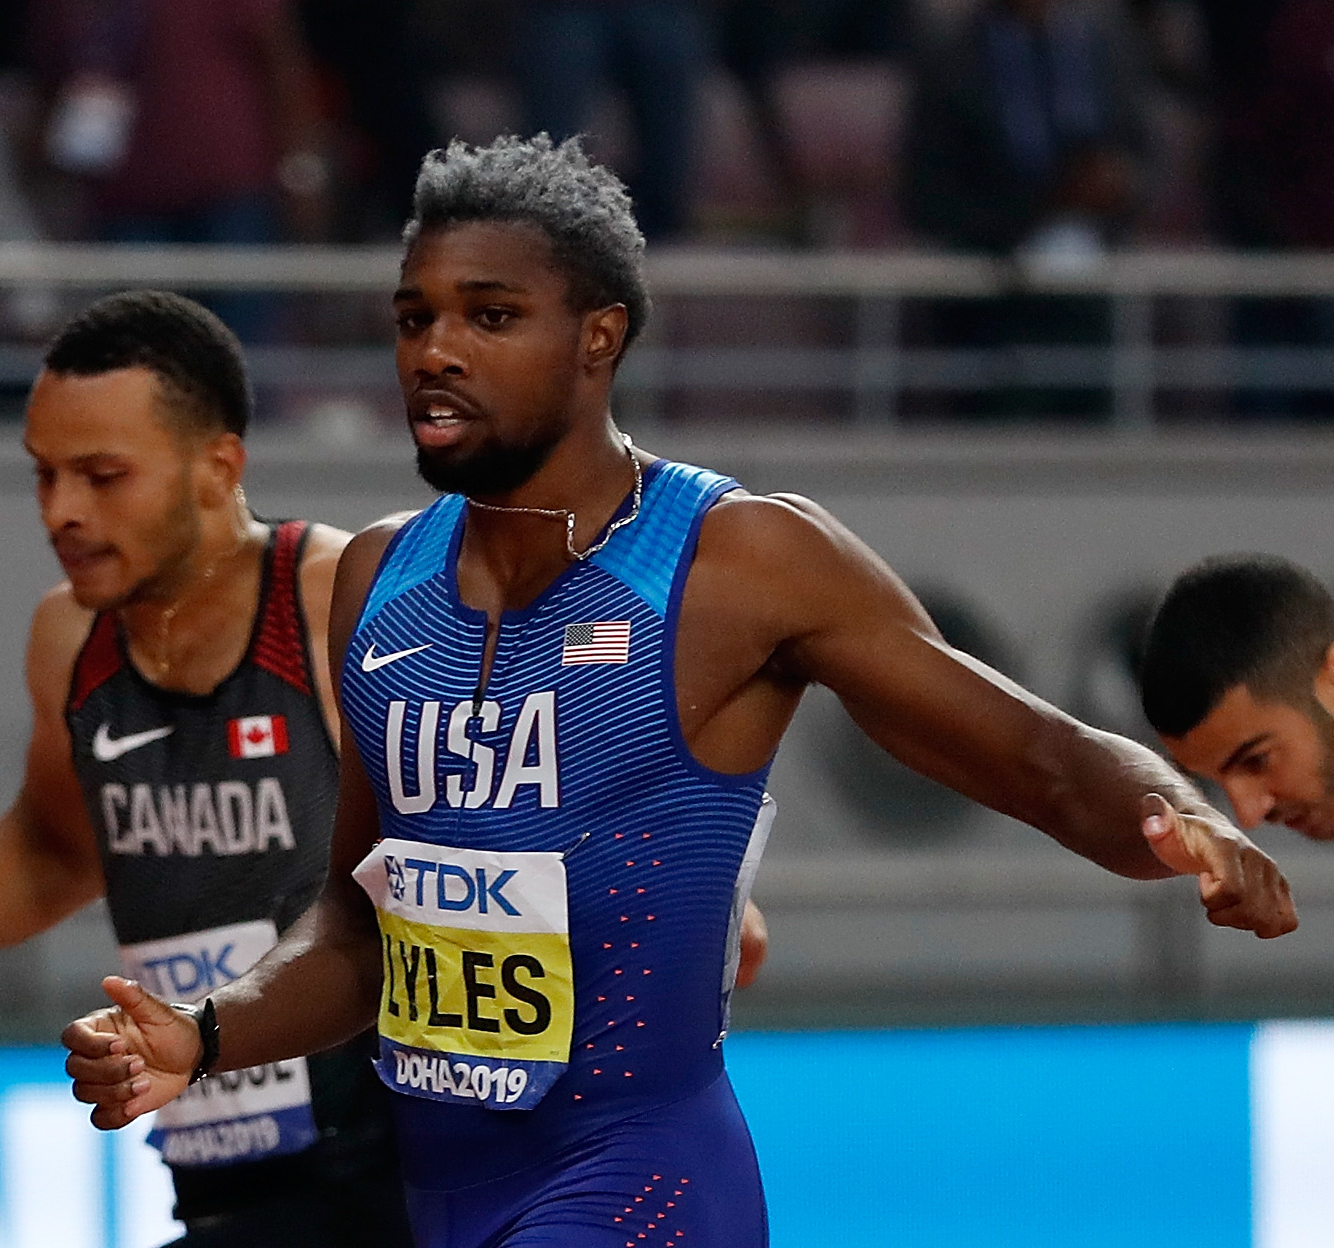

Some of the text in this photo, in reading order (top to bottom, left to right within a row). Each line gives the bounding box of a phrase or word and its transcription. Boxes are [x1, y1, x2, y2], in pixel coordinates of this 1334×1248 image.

[386, 690, 560, 815] USA
[101, 776, 297, 857] CANADA
[404, 857, 523, 917] TDK
[143, 943, 243, 996] TDK
[385, 933, 552, 1036] LYLES
[392, 1050, 529, 1103] DOHA2019
